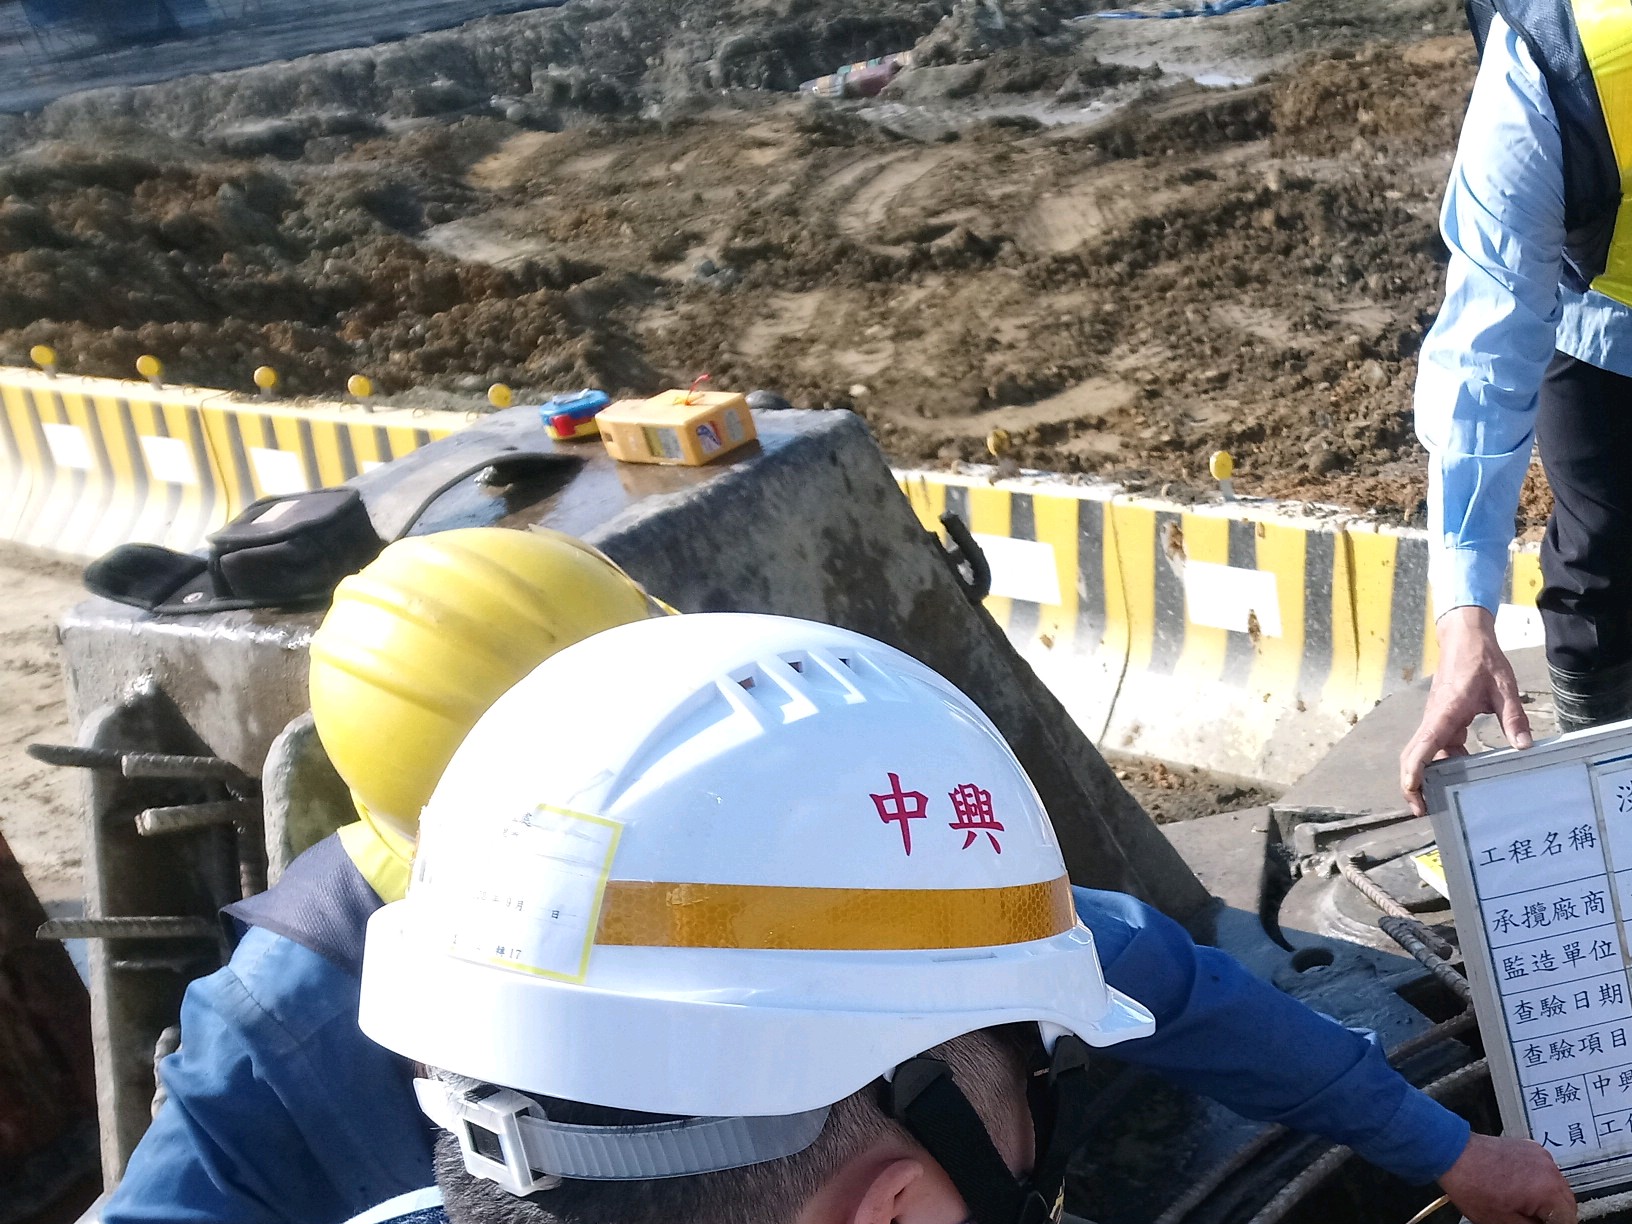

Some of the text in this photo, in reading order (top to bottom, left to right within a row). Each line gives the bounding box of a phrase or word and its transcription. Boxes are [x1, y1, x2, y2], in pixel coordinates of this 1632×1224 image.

[868, 772, 1005, 856] 中興
[1479, 823, 1597, 866] 工程名稱
[1492, 889, 1605, 934] 承攬廠商
[1502, 939, 1617, 981] 監造單位
[1512, 983, 1624, 1025] 查驗日期
[1522, 1027, 1627, 1068] 查驗項目
[1528, 1082, 1582, 1111] 查驗
[1542, 1121, 1587, 1148] 人員
